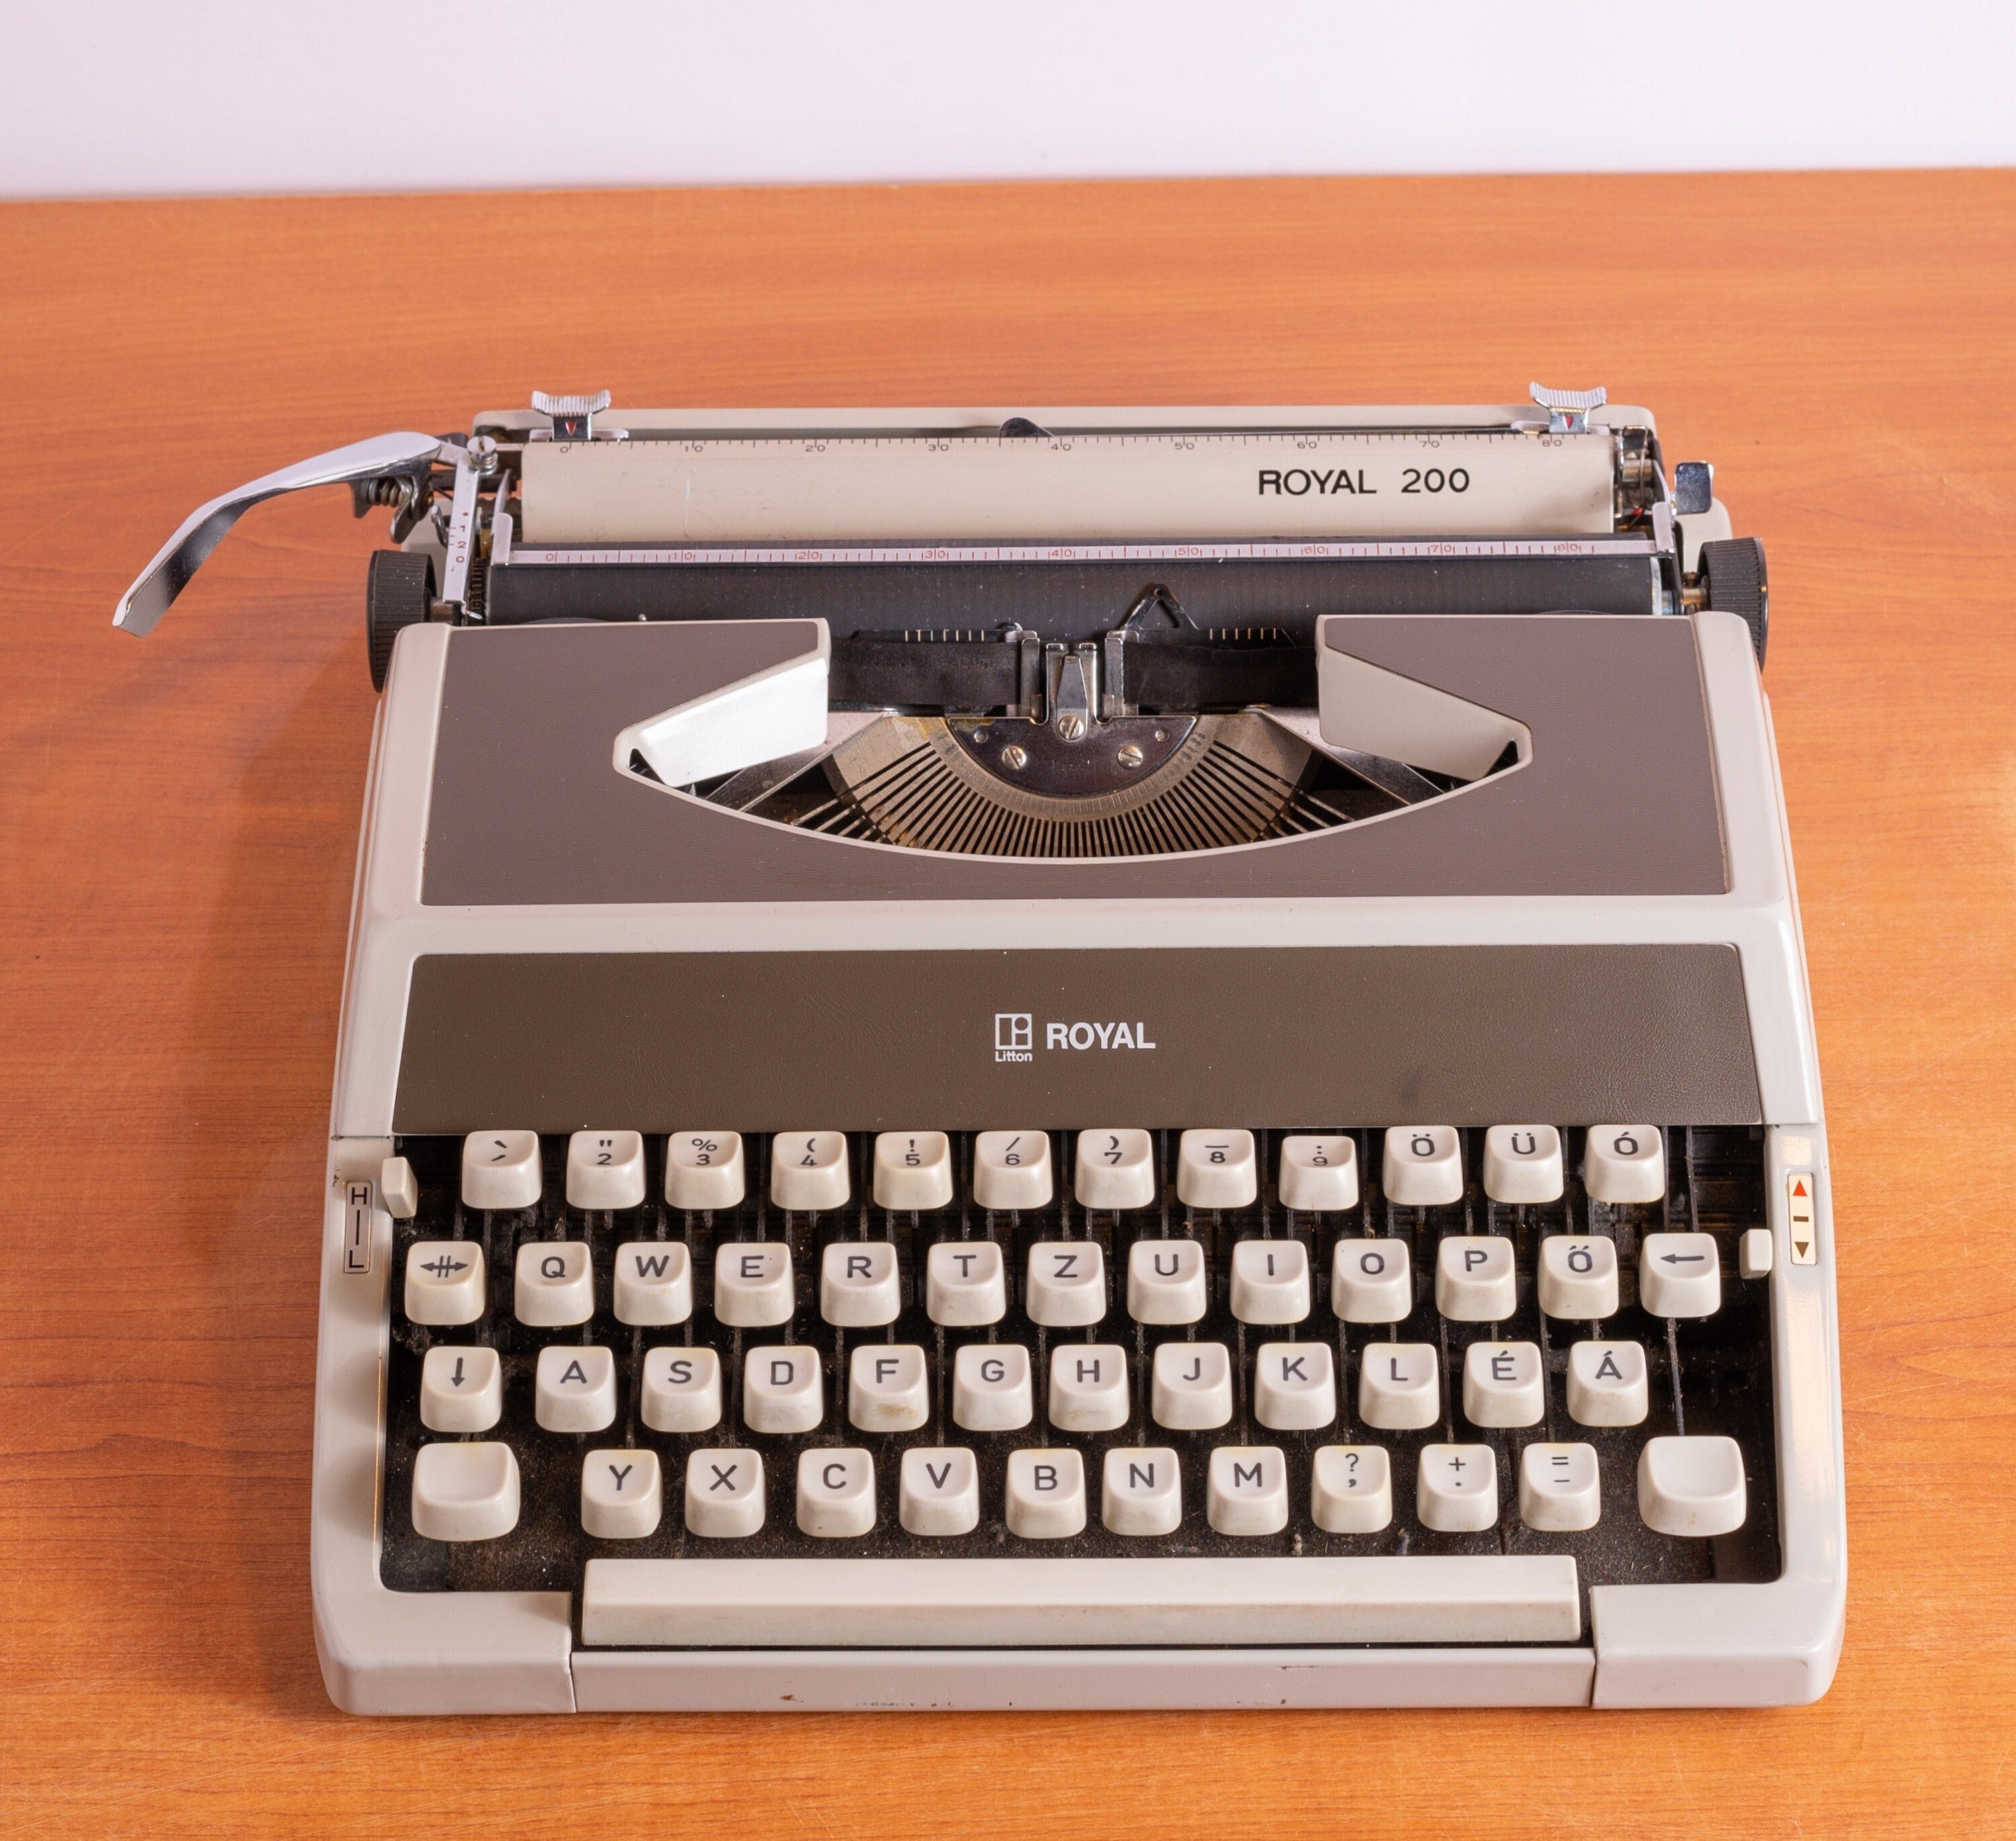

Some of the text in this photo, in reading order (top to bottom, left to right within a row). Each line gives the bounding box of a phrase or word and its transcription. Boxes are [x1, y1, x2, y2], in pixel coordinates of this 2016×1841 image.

[806, 444, 825, 452] 20
[928, 443, 949, 452] 30
[1051, 443, 1071, 451] 40
[1175, 441, 1195, 450] 50
[1297, 441, 1317, 449] 60
[1542, 439, 1562, 447] 80
[1259, 468, 1469, 495] ROYAL 200
[673, 552, 692, 560] 10
[798, 551, 819, 560] 20
[925, 550, 946, 558] 30
[1051, 548, 1073, 558] 40
[1179, 547, 1199, 556] 50
[1304, 546, 1325, 554] 60
[1431, 544, 1452, 553] 70
[1557, 543, 1579, 552] 80
[1047, 1023, 1156, 1050] ROYAL
[995, 1051, 1032, 1062] Litton
[692, 1139, 717, 1151] %
[807, 1138, 815, 1152] (
[909, 1140, 915, 1152] !
[1006, 1137, 1020, 1151] /
[1110, 1136, 1119, 1150] )
[1411, 1134, 1435, 1156] Ö
[1511, 1133, 1536, 1154] Ü
[1614, 1132, 1638, 1155] Ó
[597, 1154, 612, 1165] 2
[696, 1154, 710, 1165] 3
[801, 1155, 817, 1166] 4
[906, 1154, 920, 1166] 5
[1005, 1154, 1020, 1165] 6
[1105, 1152, 1122, 1164] 7
[1210, 1152, 1226, 1163] 8
[1313, 1157, 1328, 1166] 9
[351, 1187, 367, 1205] H
[349, 1250, 364, 1268] L
[542, 1256, 565, 1278] Q
[636, 1256, 669, 1277] W
[741, 1256, 764, 1277] E
[847, 1256, 872, 1278] R
[953, 1255, 976, 1277] T
[1054, 1255, 1078, 1278] Z
[1155, 1254, 1178, 1276] U
[1361, 1253, 1384, 1275] O
[1465, 1250, 1487, 1272] P
[1568, 1246, 1592, 1273] Ő
[560, 1361, 587, 1383] A
[669, 1361, 692, 1383] S
[771, 1361, 794, 1385] D
[876, 1359, 899, 1383] F
[981, 1360, 1004, 1382] G
[1077, 1360, 1099, 1382] H
[1183, 1358, 1200, 1381] J
[1283, 1357, 1307, 1381] K
[1391, 1358, 1408, 1381] L
[1492, 1351, 1517, 1380] É
[1595, 1351, 1622, 1379] Á
[1345, 1453, 1358, 1471] ?
[1449, 1457, 1466, 1471] +
[1552, 1457, 1568, 1465] =
[609, 1465, 632, 1490] Y
[710, 1465, 737, 1490] X
[823, 1464, 846, 1489] C
[926, 1463, 952, 1488] V
[1035, 1465, 1057, 1490] B
[1130, 1463, 1154, 1488] N
[1234, 1463, 1262, 1487] M
